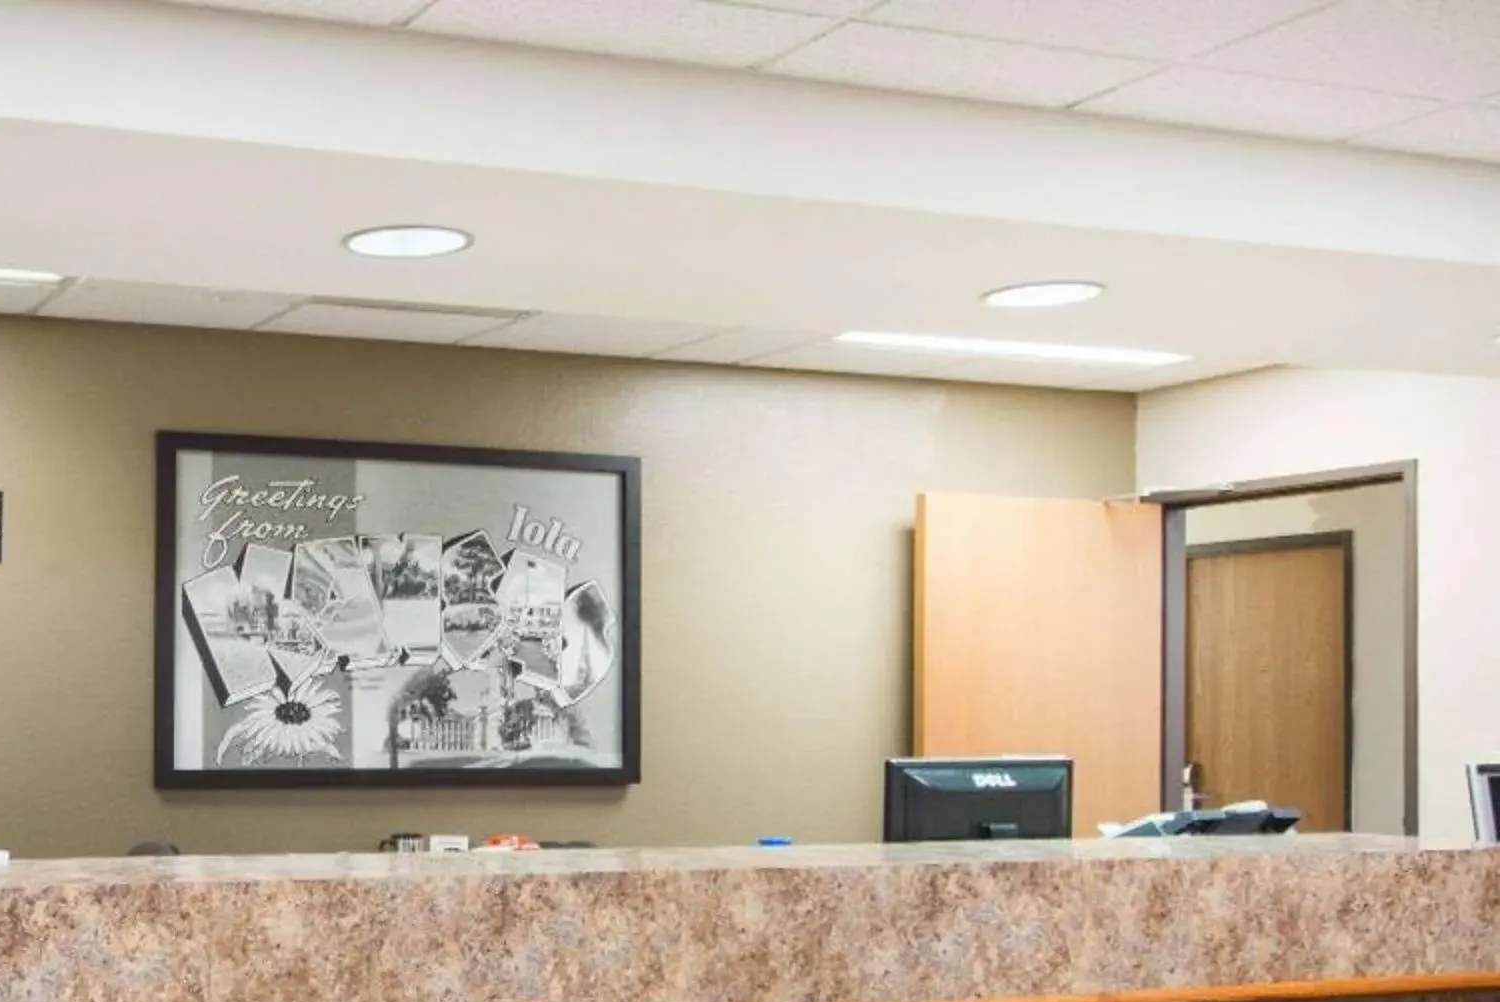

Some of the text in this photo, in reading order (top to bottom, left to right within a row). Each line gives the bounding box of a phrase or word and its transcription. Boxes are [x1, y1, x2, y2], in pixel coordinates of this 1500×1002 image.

[198, 475, 365, 524] Greetings
[203, 511, 310, 569] from
[506, 504, 583, 563] Iola
[971, 773, 1018, 788] DELL
